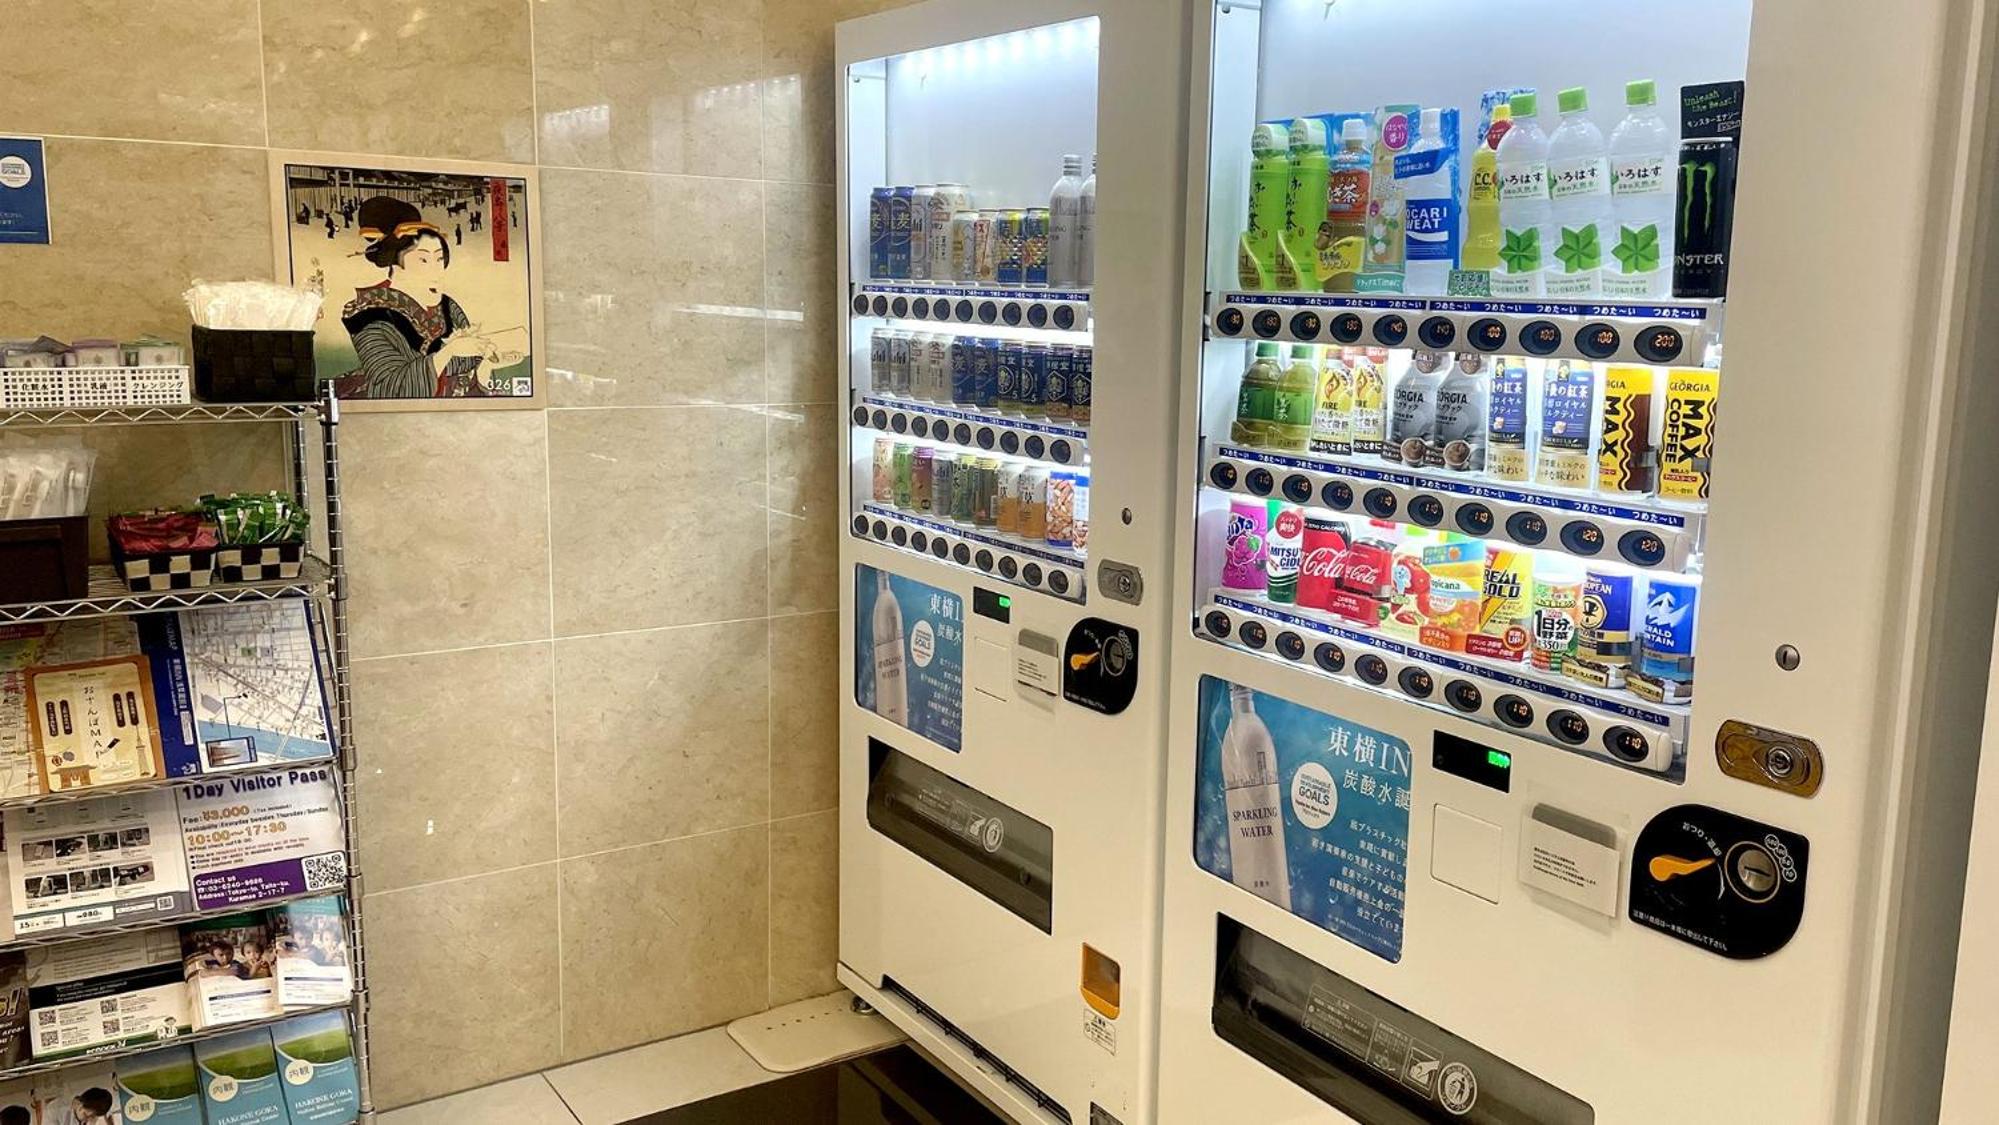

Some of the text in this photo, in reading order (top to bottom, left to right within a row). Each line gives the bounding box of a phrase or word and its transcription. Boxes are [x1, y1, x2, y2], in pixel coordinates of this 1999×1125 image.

[1553, 167, 1598, 183] いろはす
[1615, 165, 1662, 180] いろはす
[1406, 206, 1447, 220] OCARI
[1406, 217, 1442, 230] WEAT
[1655, 334, 1675, 347] 200
[132, 381, 184, 390] クレンジング
[1601, 395, 1621, 458] MAX
[1665, 398, 1706, 464] MAX COFFEE
[1270, 546, 1300, 558] MITSU
[1431, 579, 1461, 590] opicana
[1484, 570, 1520, 585] REAL
[183, 769, 327, 800] 1Day Visitor Pass
[1298, 786, 1330, 806] GOALS
[1233, 806, 1277, 821] SPARKLING
[1241, 825, 1274, 838] WATER
[195, 877, 225, 887] Contact
